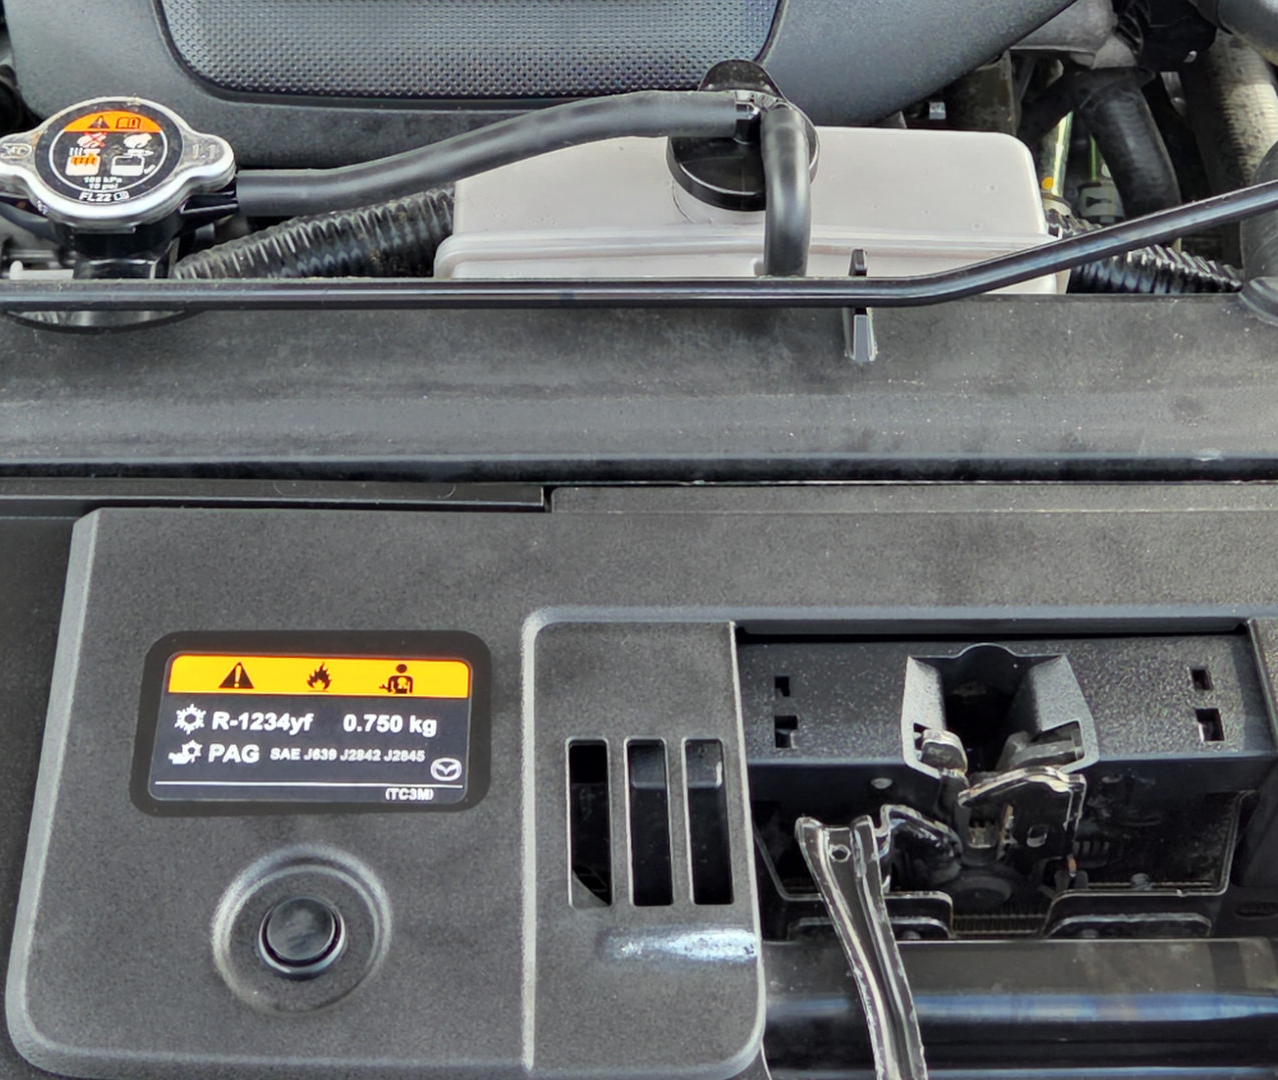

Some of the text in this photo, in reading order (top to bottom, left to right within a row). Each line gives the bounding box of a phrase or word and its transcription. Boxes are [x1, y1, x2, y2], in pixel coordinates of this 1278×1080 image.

[78, 191, 112, 202] FL22
[212, 711, 438, 738] R-1234yf 0.750 kg
[208, 743, 426, 763] PAG SAE J639 J2842 J2845
[385, 787, 434, 801] (TC3M)
